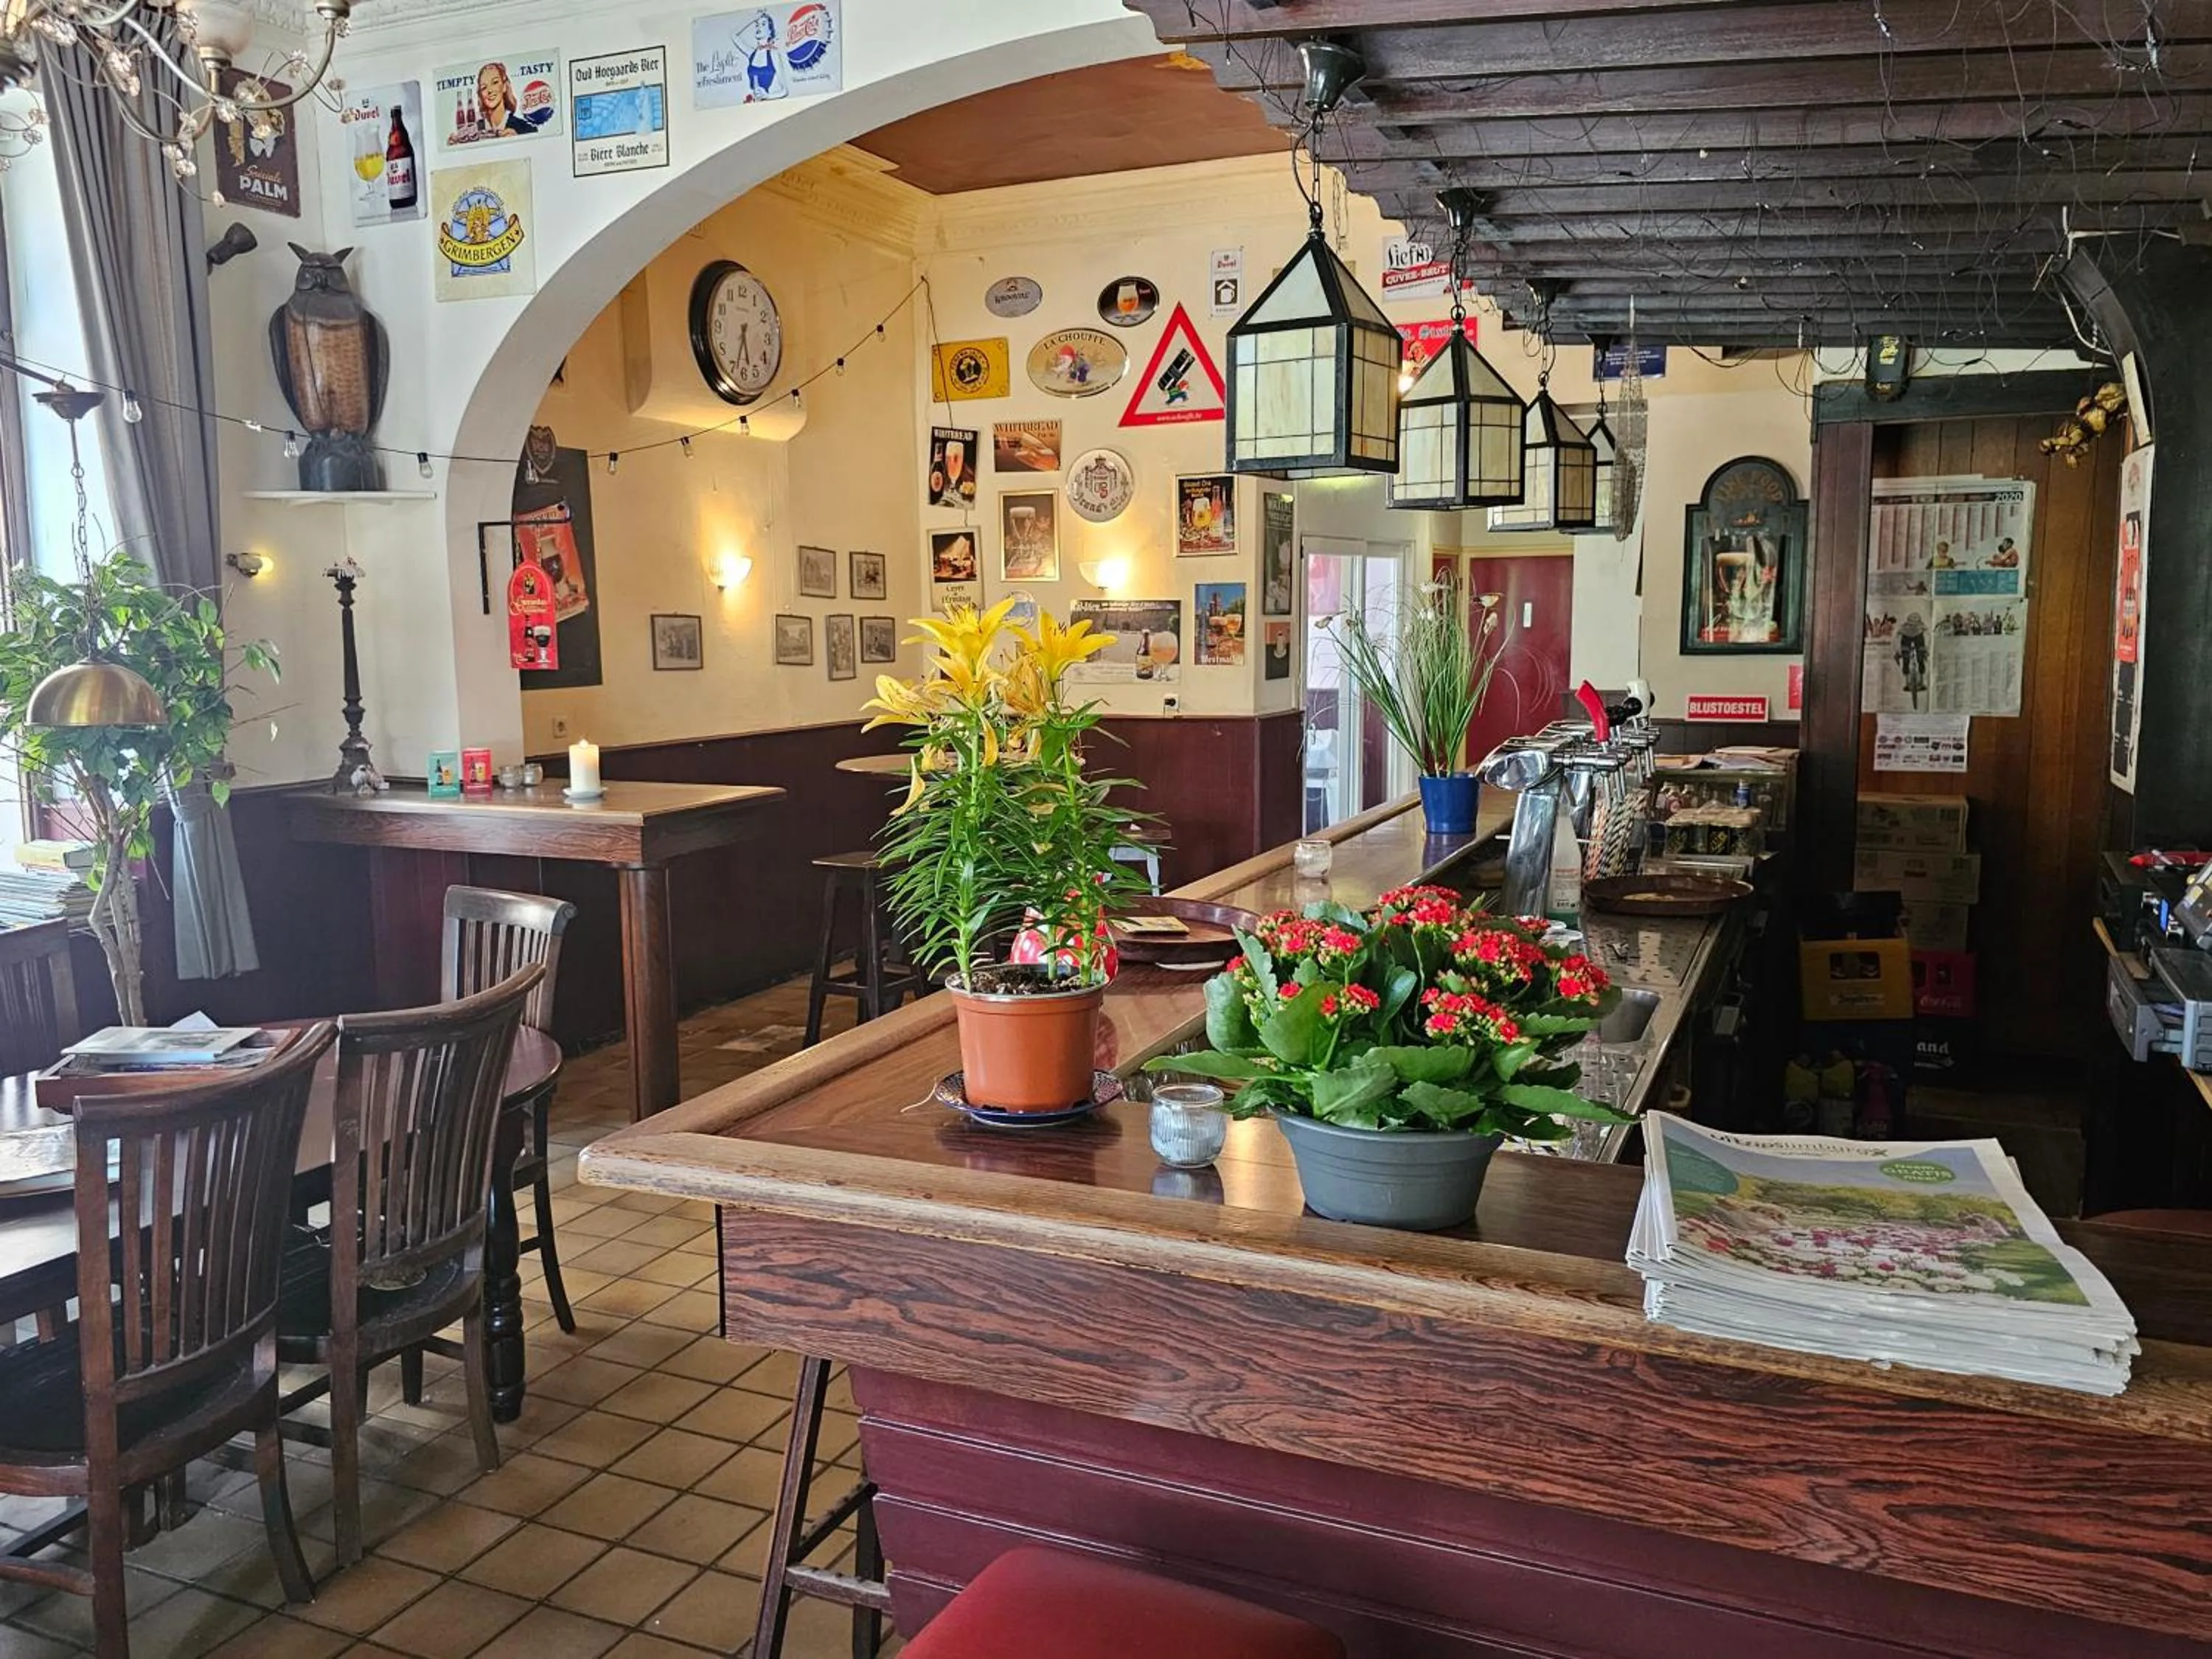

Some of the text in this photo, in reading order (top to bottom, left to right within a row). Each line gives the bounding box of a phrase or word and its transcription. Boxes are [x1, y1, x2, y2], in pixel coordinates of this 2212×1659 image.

[576, 68, 592, 81] Oud
[641, 58, 659, 72] Bier
[696, 61, 709, 73] The
[437, 74, 476, 91] TEMPTY
[239, 175, 288, 201] PALM
[443, 232, 516, 262] GRIMBERGEN
[726, 289, 734, 302] 11
[738, 285, 747, 298] 12
[752, 294, 757, 307] 1
[717, 303, 726, 316] 10
[759, 310, 768, 323] 2
[714, 319, 722, 333] 9
[763, 333, 771, 345] 3
[1043, 332, 1105, 350] LA CHOUFFE
[760, 349, 768, 364] 4
[728, 361, 737, 374] 7
[740, 368, 748, 380] 6
[752, 364, 759, 378] 5
[995, 421, 1058, 434] WHITBREAD
[933, 429, 974, 442] WHITBREAD
[1994, 492, 2023, 504] 2020
[1689, 702, 1764, 714] BLUSTOESTEL
[1916, 1039, 1950, 1054] and
[1882, 1167, 1952, 1178] GRATIS
